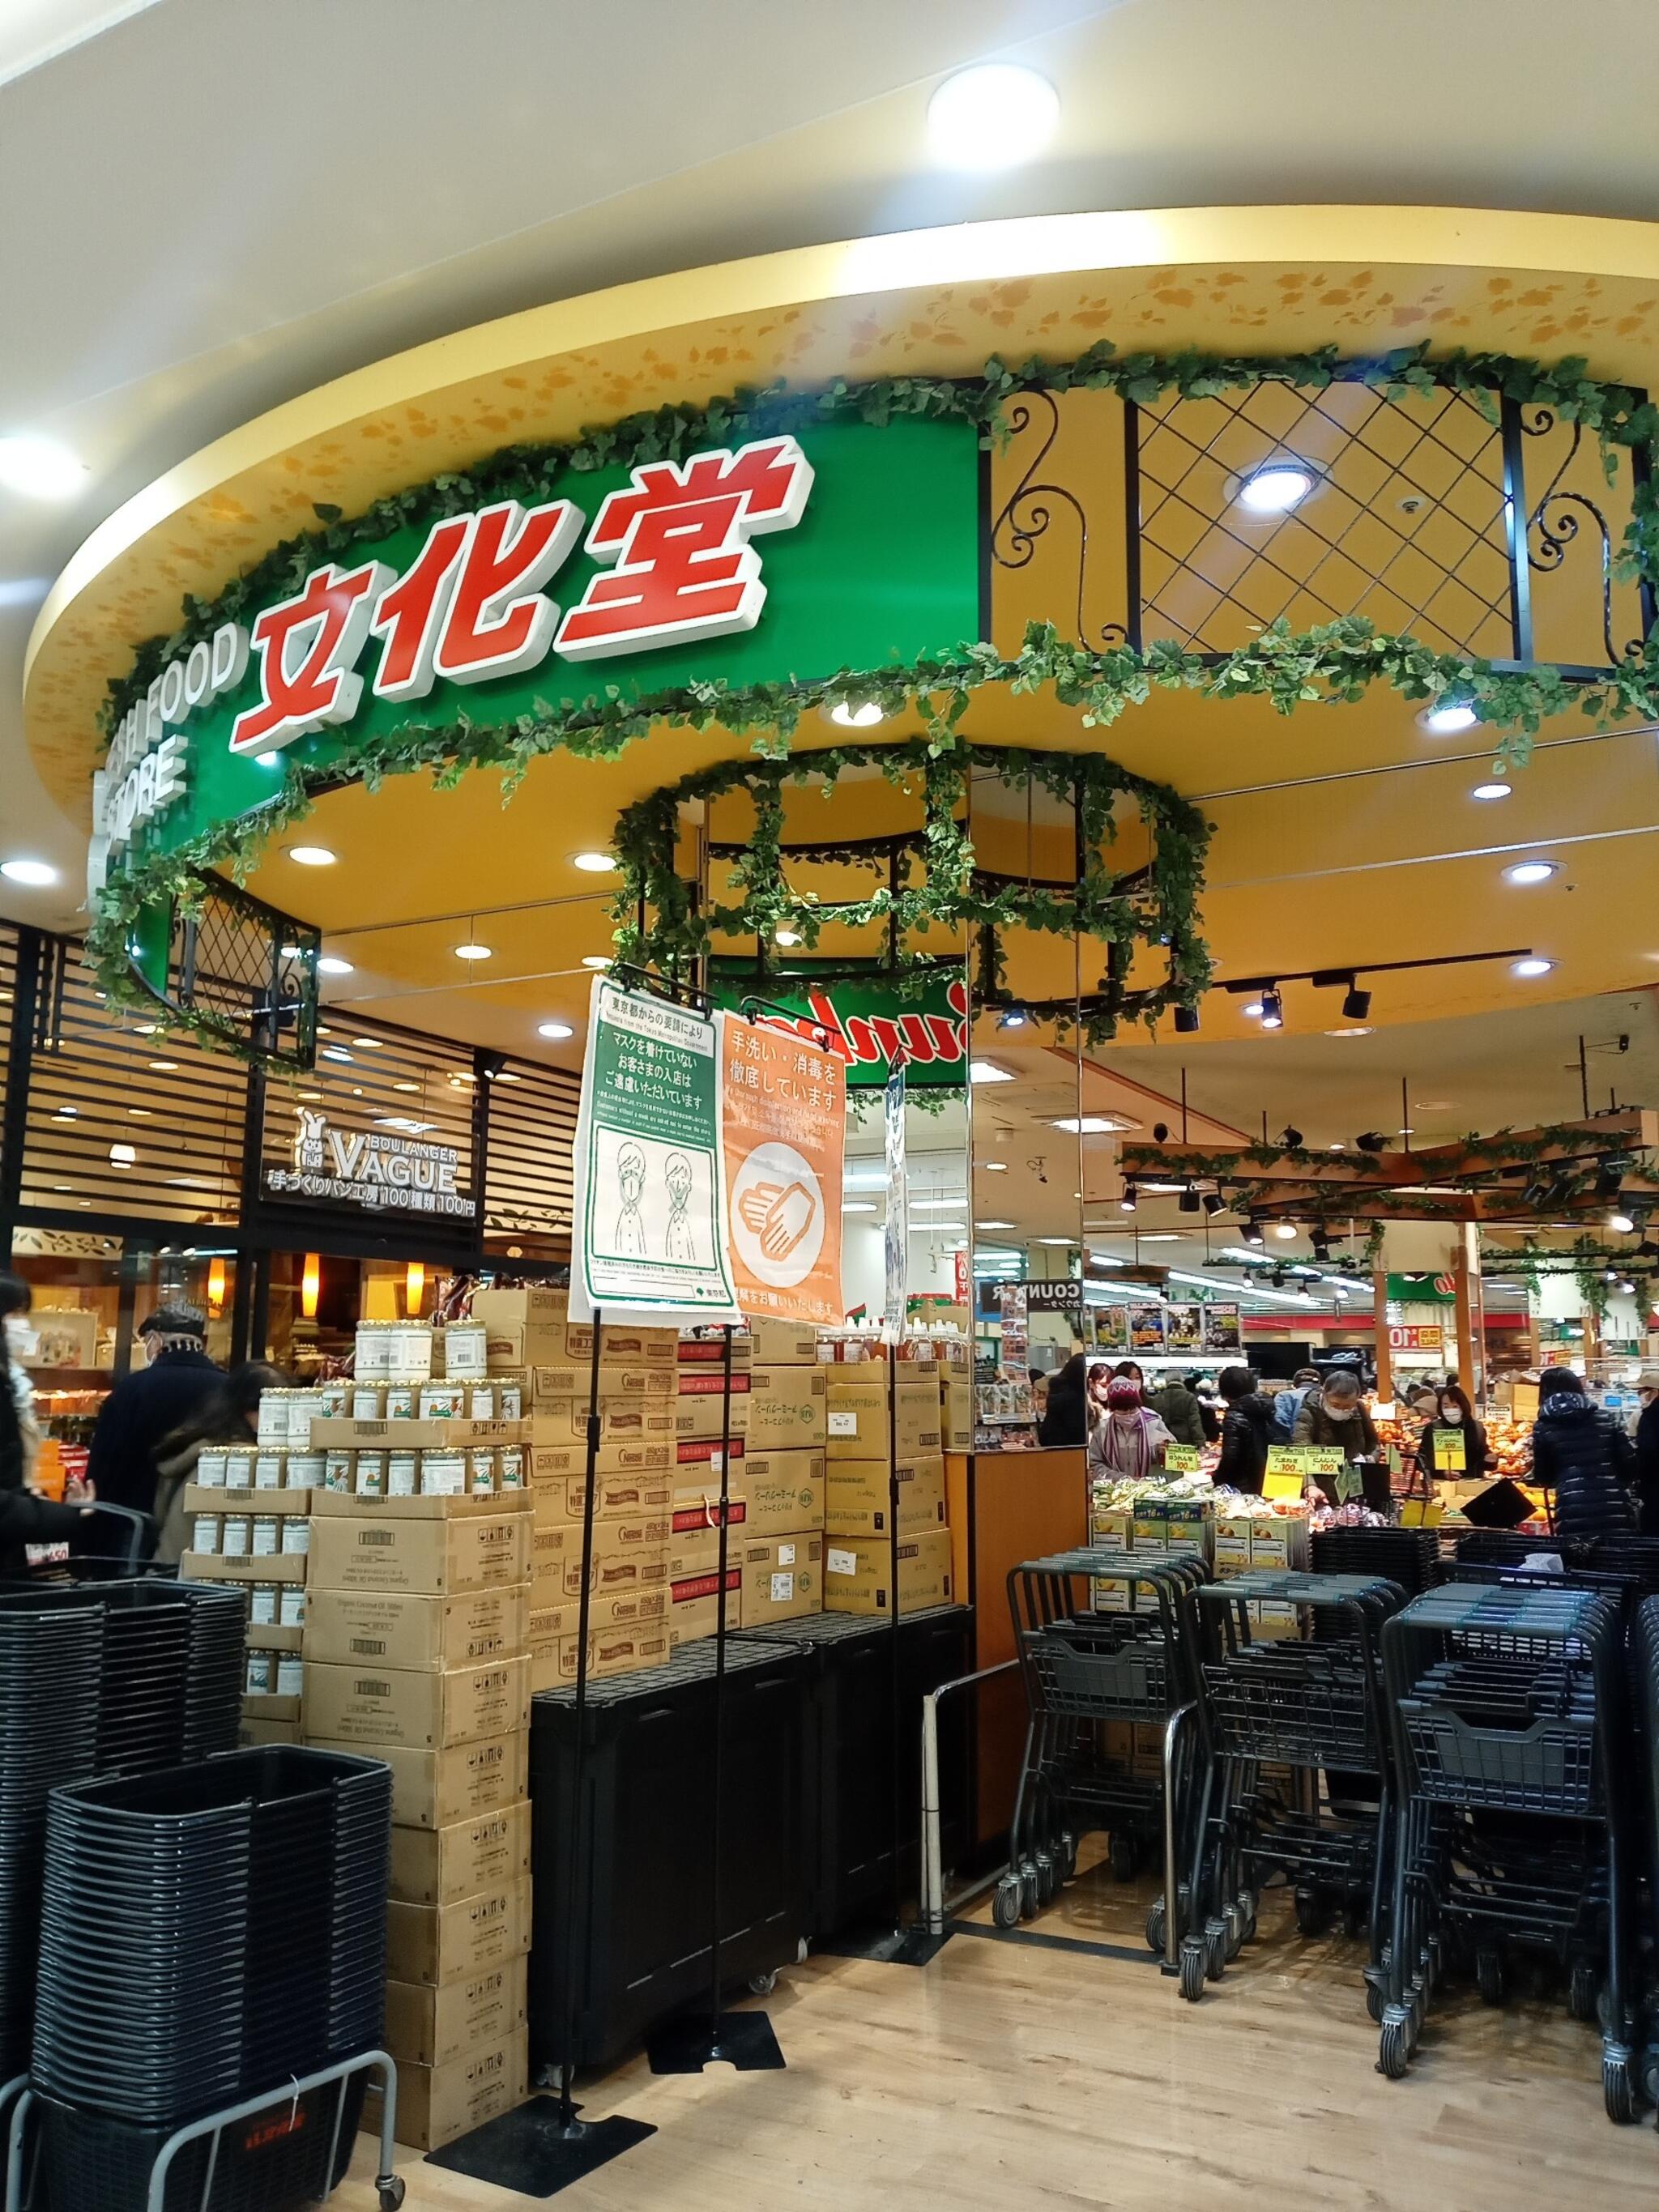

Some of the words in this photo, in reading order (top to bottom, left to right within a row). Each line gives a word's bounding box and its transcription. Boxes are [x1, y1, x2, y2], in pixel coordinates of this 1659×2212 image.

[230, 434, 814, 757] 文化堂
[147, 622, 245, 741] FOOD
[612, 997, 703, 1040] 東京都からの要請により
[612, 1031, 697, 1069] マスクを着けていない
[617, 1052, 692, 1088] お客さまの入店は
[731, 1029, 836, 1086] 手洗い・消毒を
[605, 1069, 702, 1110] ご遠慮いただいています
[730, 1058, 837, 1112] 徹底しています
[329, 1130, 458, 1194] VAGUE
[370, 1135, 458, 1163] BOULANGER
[268, 1170, 379, 1203] 手づくりパン工房
[384, 1184, 436, 1211] 100種類
[438, 1194, 476, 1217] 100円
[1176, 1461, 1188, 1469] 100
[1282, 1464, 1296, 1472] 100
[1320, 1464, 1334, 1472] 100
